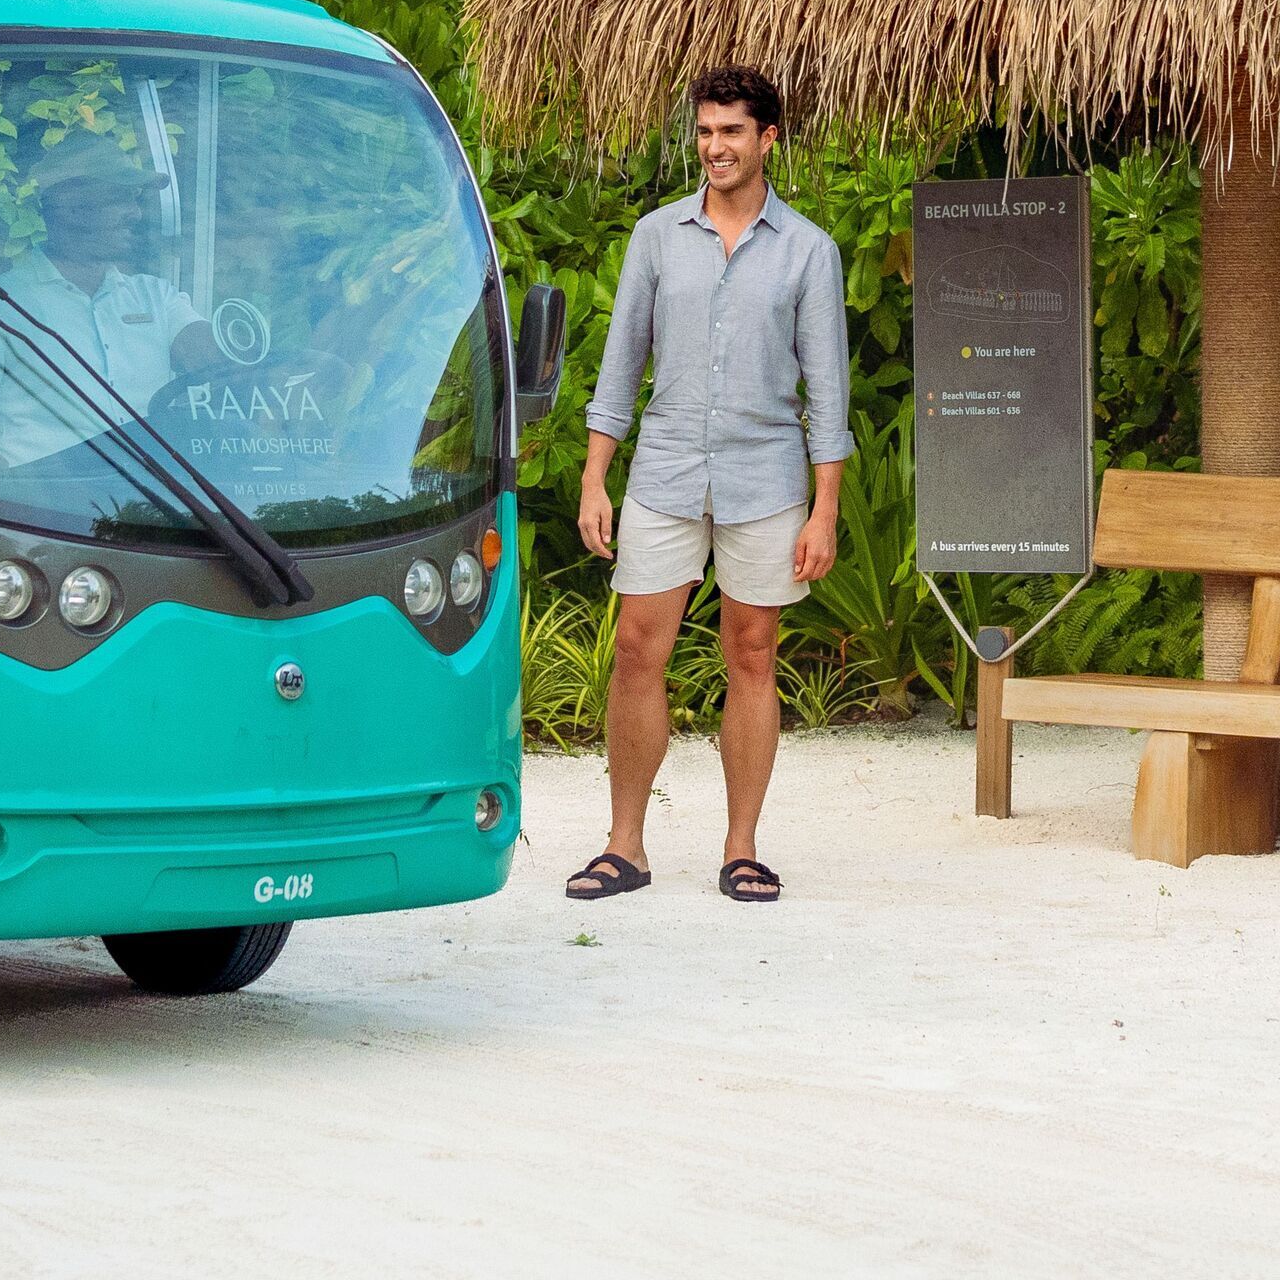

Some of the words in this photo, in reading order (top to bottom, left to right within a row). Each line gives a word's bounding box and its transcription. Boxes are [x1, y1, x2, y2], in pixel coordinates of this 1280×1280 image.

[925, 205, 969, 219] BEACH
[972, 203, 1010, 217] VILLA
[1013, 201, 1047, 215] STOP
[1058, 201, 1066, 214] 2
[974, 346, 992, 357] You
[995, 348, 1011, 357] are
[1013, 345, 1036, 357] here
[942, 392, 964, 400] Beach
[965, 391, 986, 400] Villas
[987, 391, 1000, 399] 637
[941, 407, 964, 416] Beach
[965, 407, 985, 415] Villas
[986, 406, 1000, 415] 601
[191, 438, 214, 455] BY
[220, 437, 336, 455] ATMOSPHERE
[234, 483, 306, 496] MALDIVES
[930, 541, 938, 551] A
[939, 541, 956, 552] bus
[957, 541, 989, 552] arrives
[991, 543, 1017, 554] every
[1018, 542, 1030, 552] 15
[1031, 541, 1070, 552] minutes
[254, 873, 313, 903] G-08
